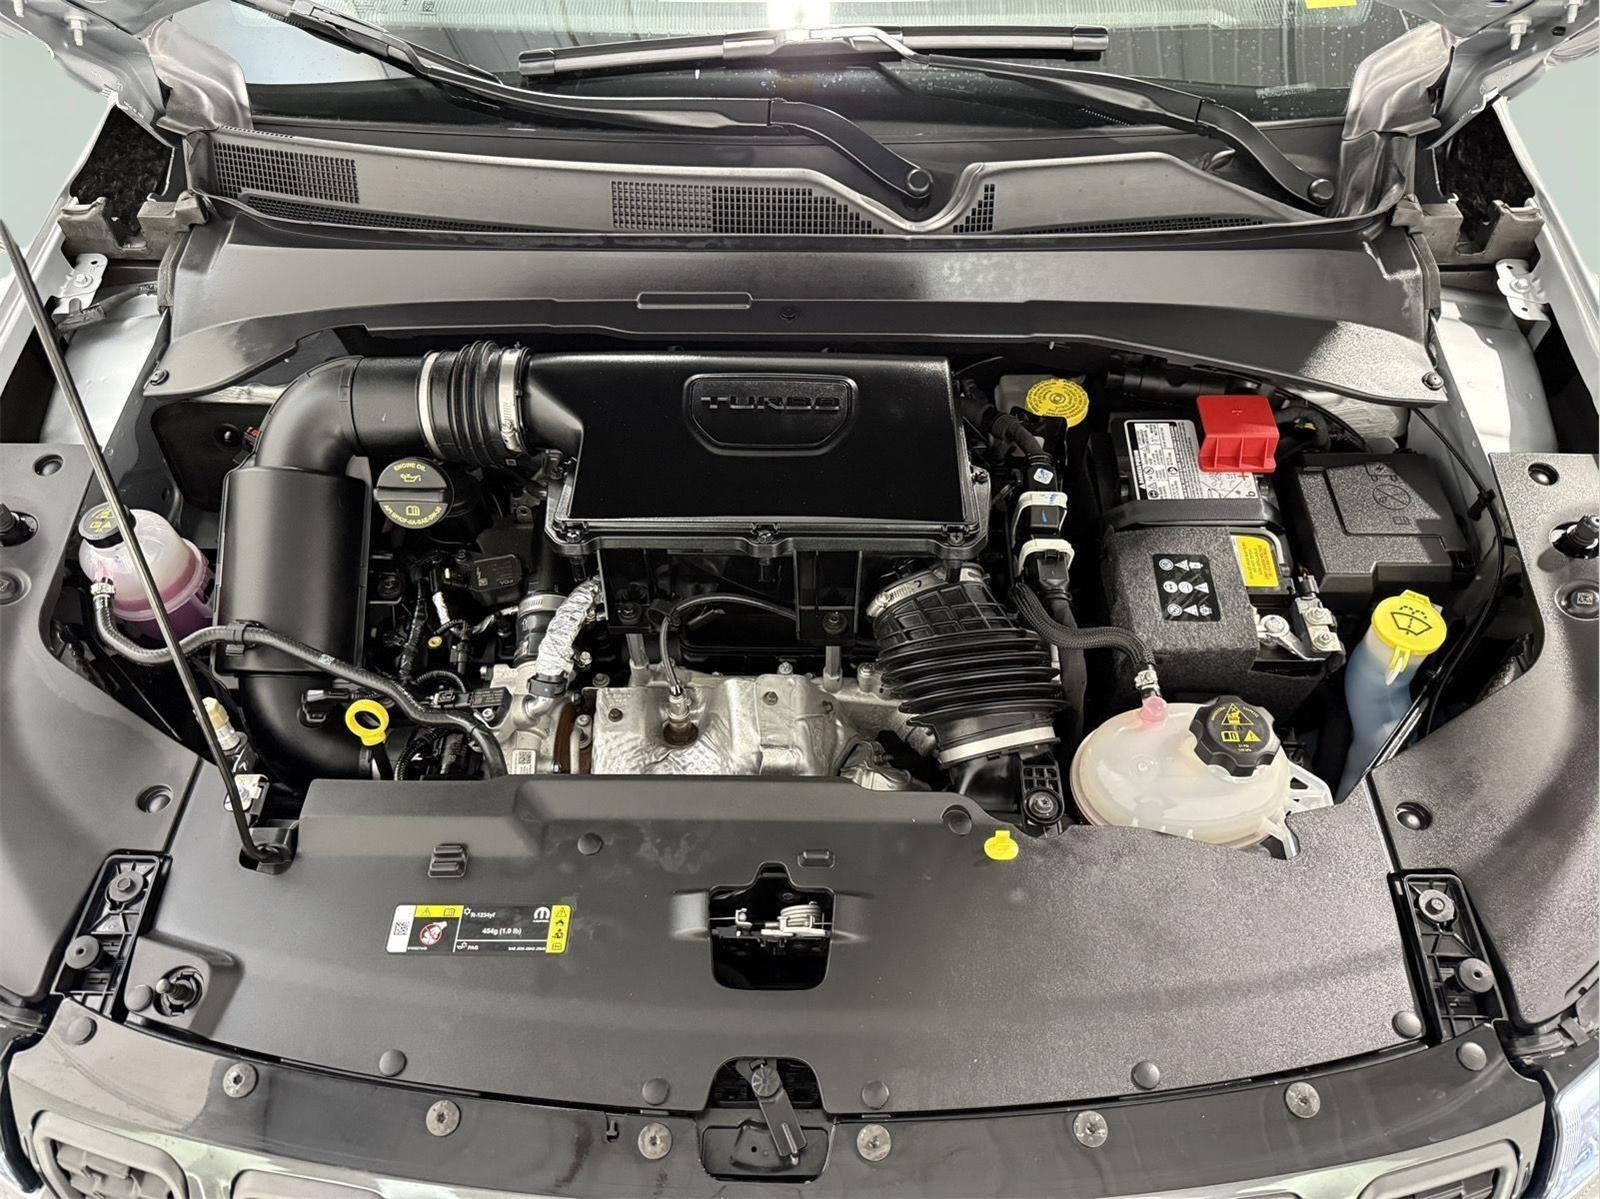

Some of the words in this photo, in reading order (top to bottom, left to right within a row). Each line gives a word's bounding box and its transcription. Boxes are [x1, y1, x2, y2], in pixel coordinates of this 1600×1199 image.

[700, 396, 841, 411] TURBO
[393, 462, 416, 472] ENGINE
[416, 463, 427, 473] OIL
[481, 927, 499, 936] 454g
